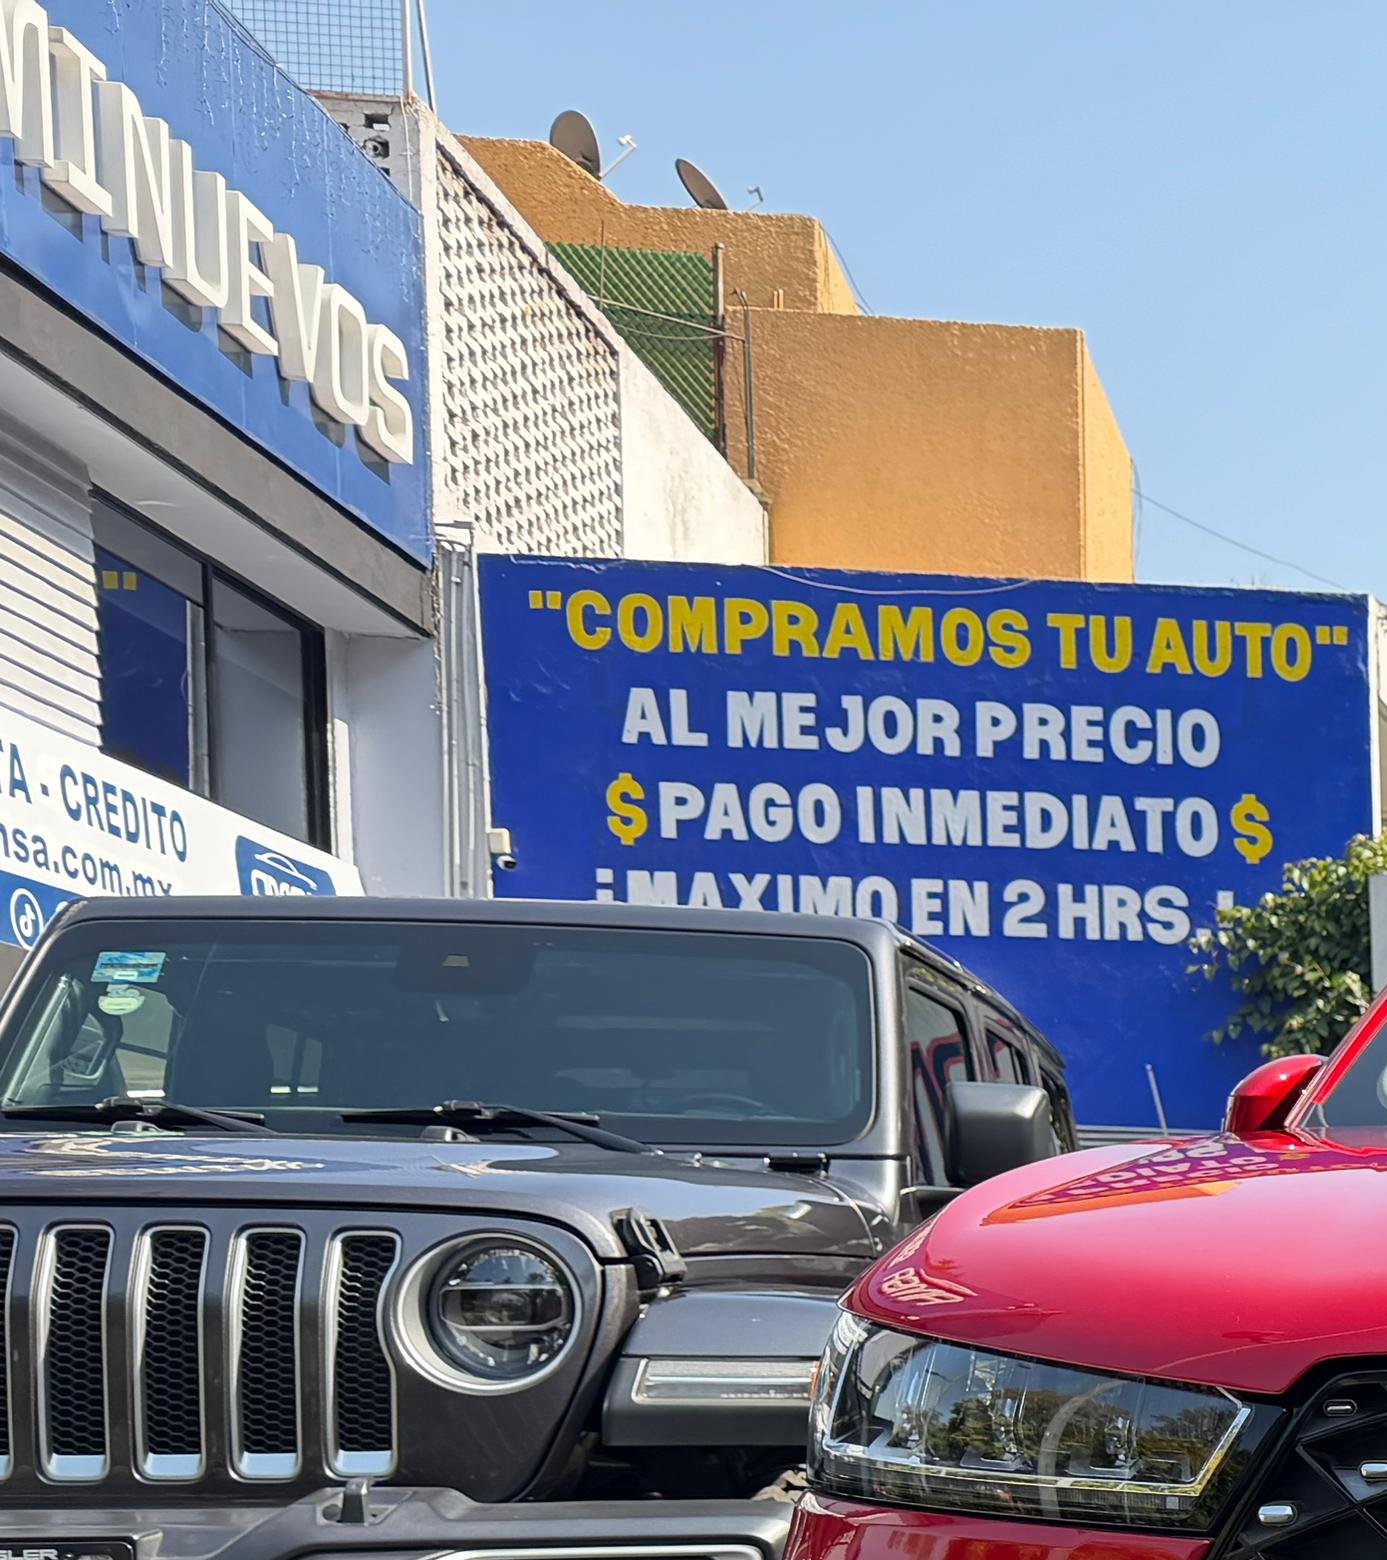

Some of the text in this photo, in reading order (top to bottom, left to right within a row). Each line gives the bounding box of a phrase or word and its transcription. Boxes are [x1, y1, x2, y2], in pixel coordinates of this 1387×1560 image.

[528, 589, 1348, 682] "COMPRAMOS TU AUTO"
[621, 686, 1221, 768] AL MEJOR PRECIO
[60, 764, 187, 862] CREDITO
[910, 878, 990, 937] EN
[1002, 879, 1048, 939] 2
